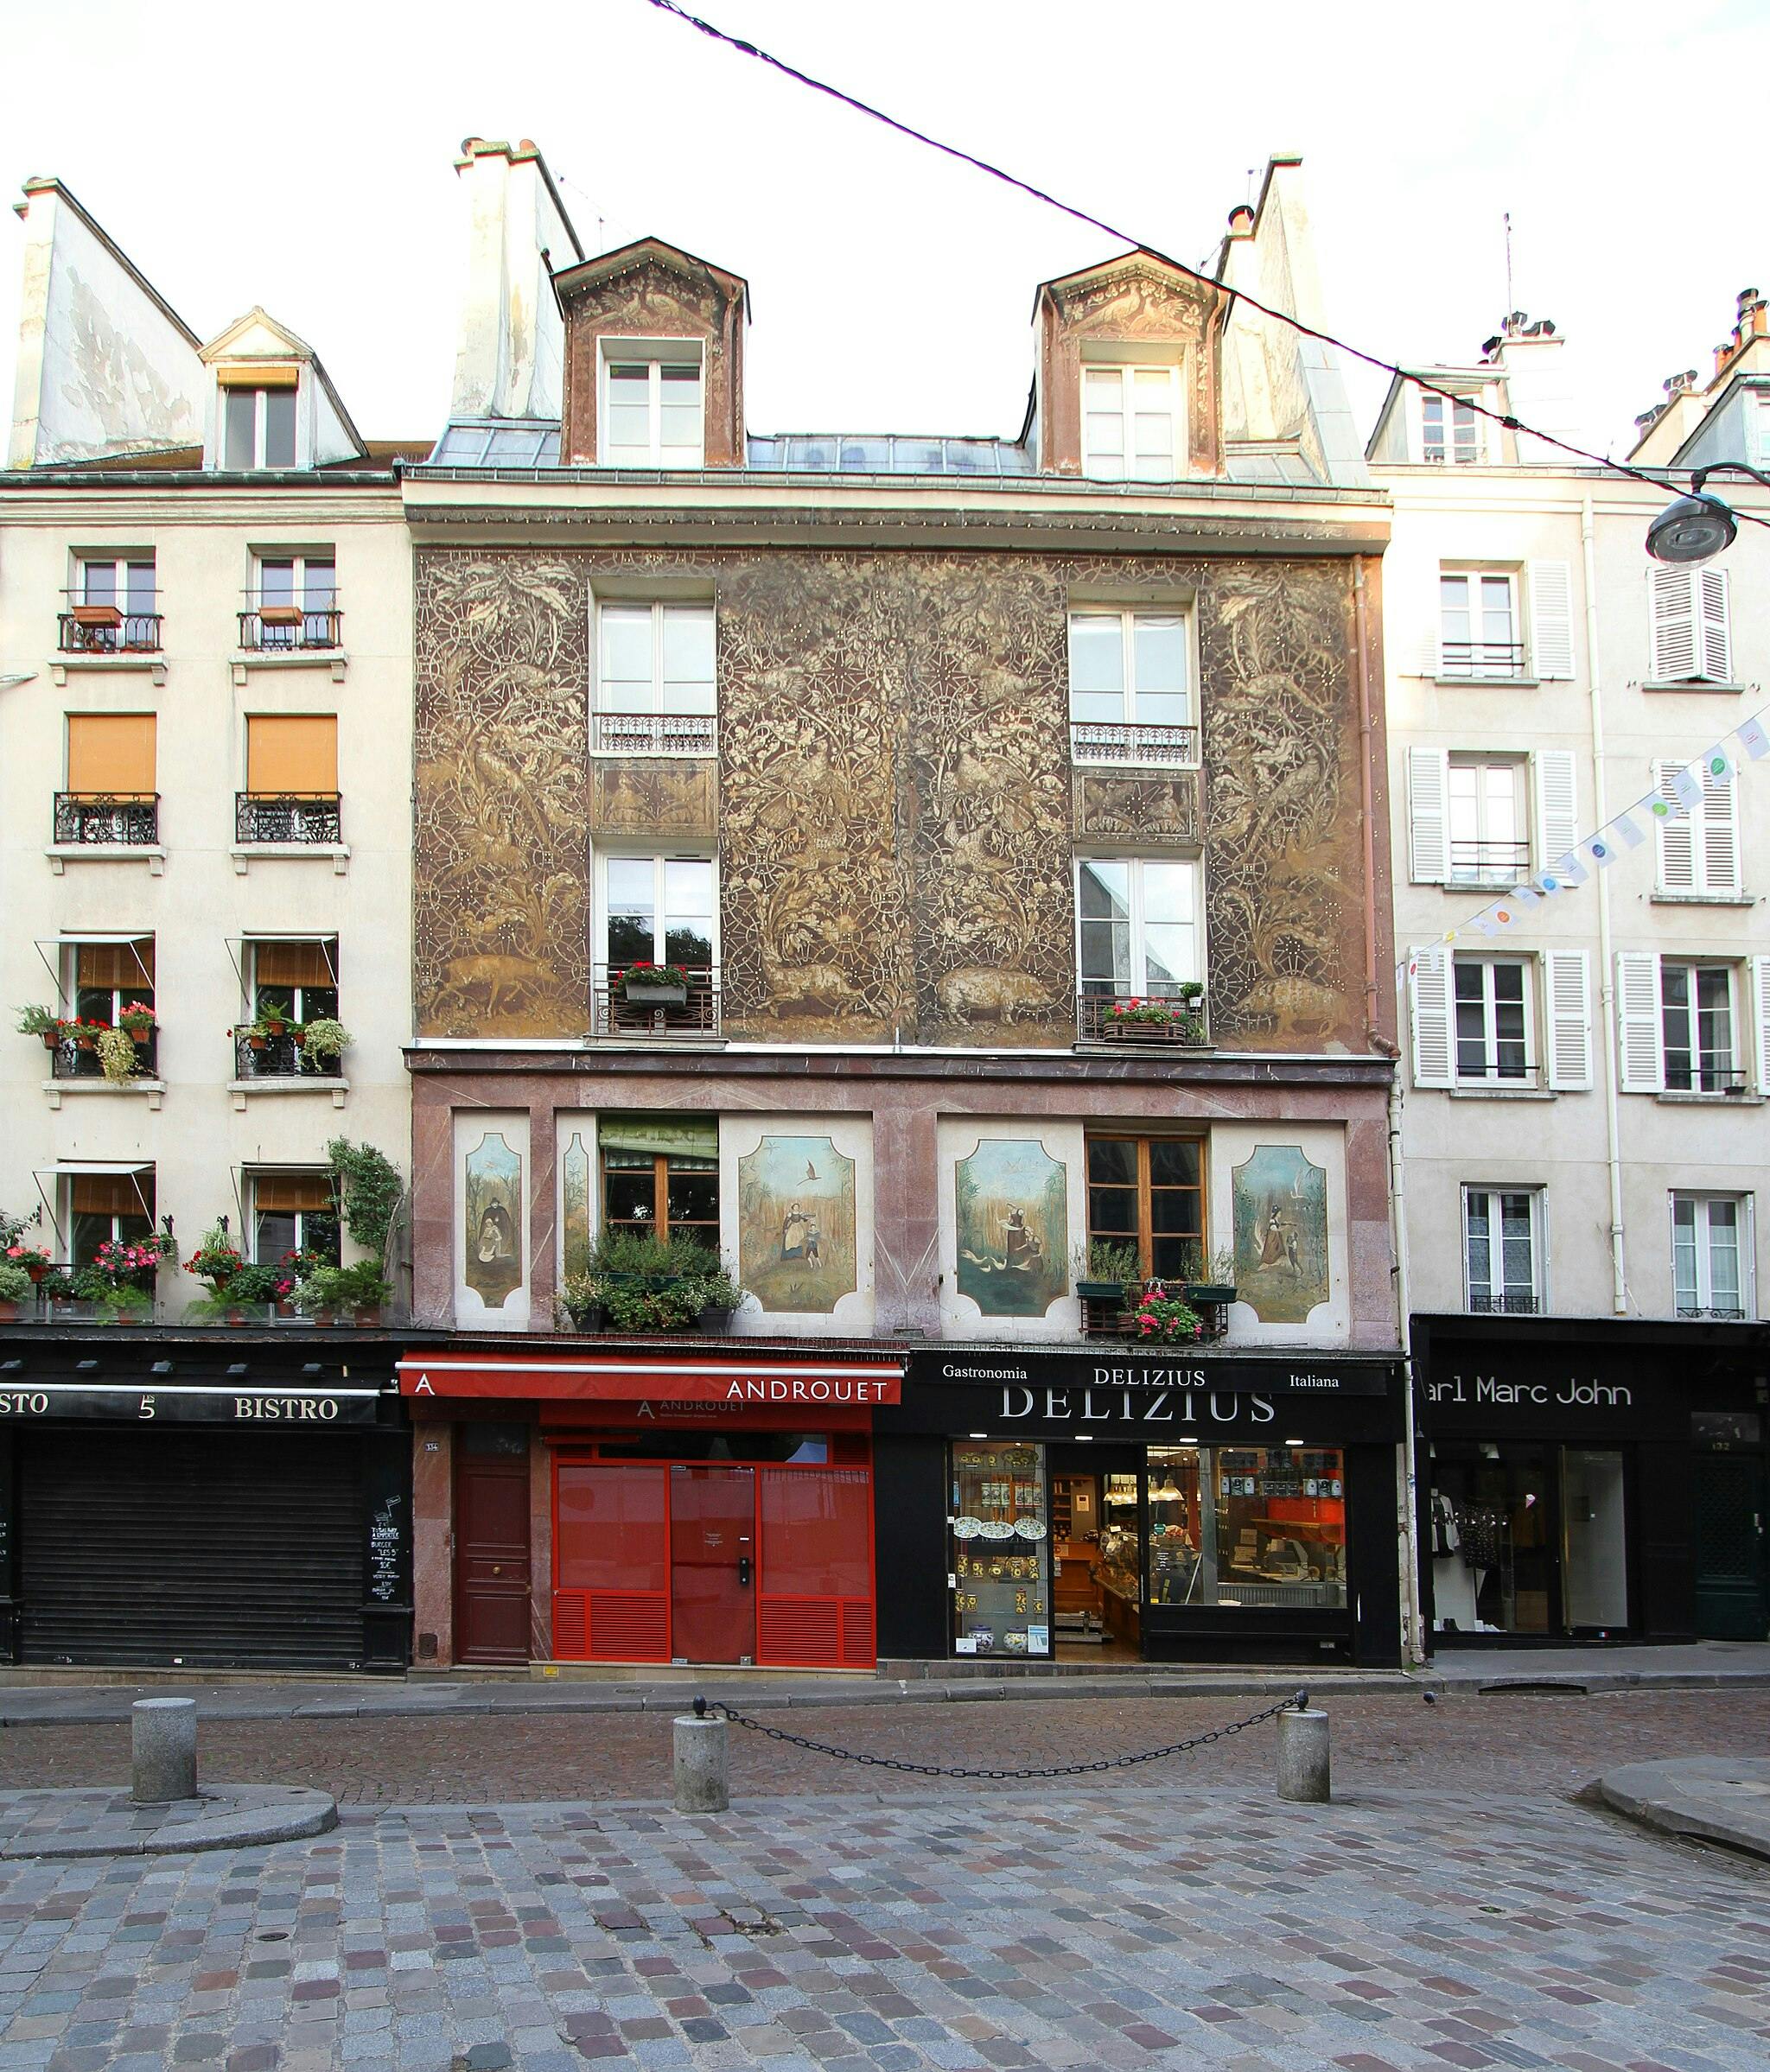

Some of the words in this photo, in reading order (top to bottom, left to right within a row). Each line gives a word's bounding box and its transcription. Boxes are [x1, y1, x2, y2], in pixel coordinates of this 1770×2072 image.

[942, 1364, 1028, 1380] Gastronomia
[1093, 1368, 1206, 1387] DELIZIUS
[1289, 1374, 1340, 1388] Italiana
[414, 1373, 436, 1395] A
[726, 1380, 888, 1401] ANDROUET
[1477, 1376, 1548, 1403] Marc
[1556, 1378, 1632, 1405] John
[0, 1393, 49, 1414] STO
[138, 1397, 156, 1419] 5
[234, 1397, 339, 1420] BISTRO
[637, 1400, 655, 1419] A
[998, 1386, 1276, 1422] DELIZIUS
